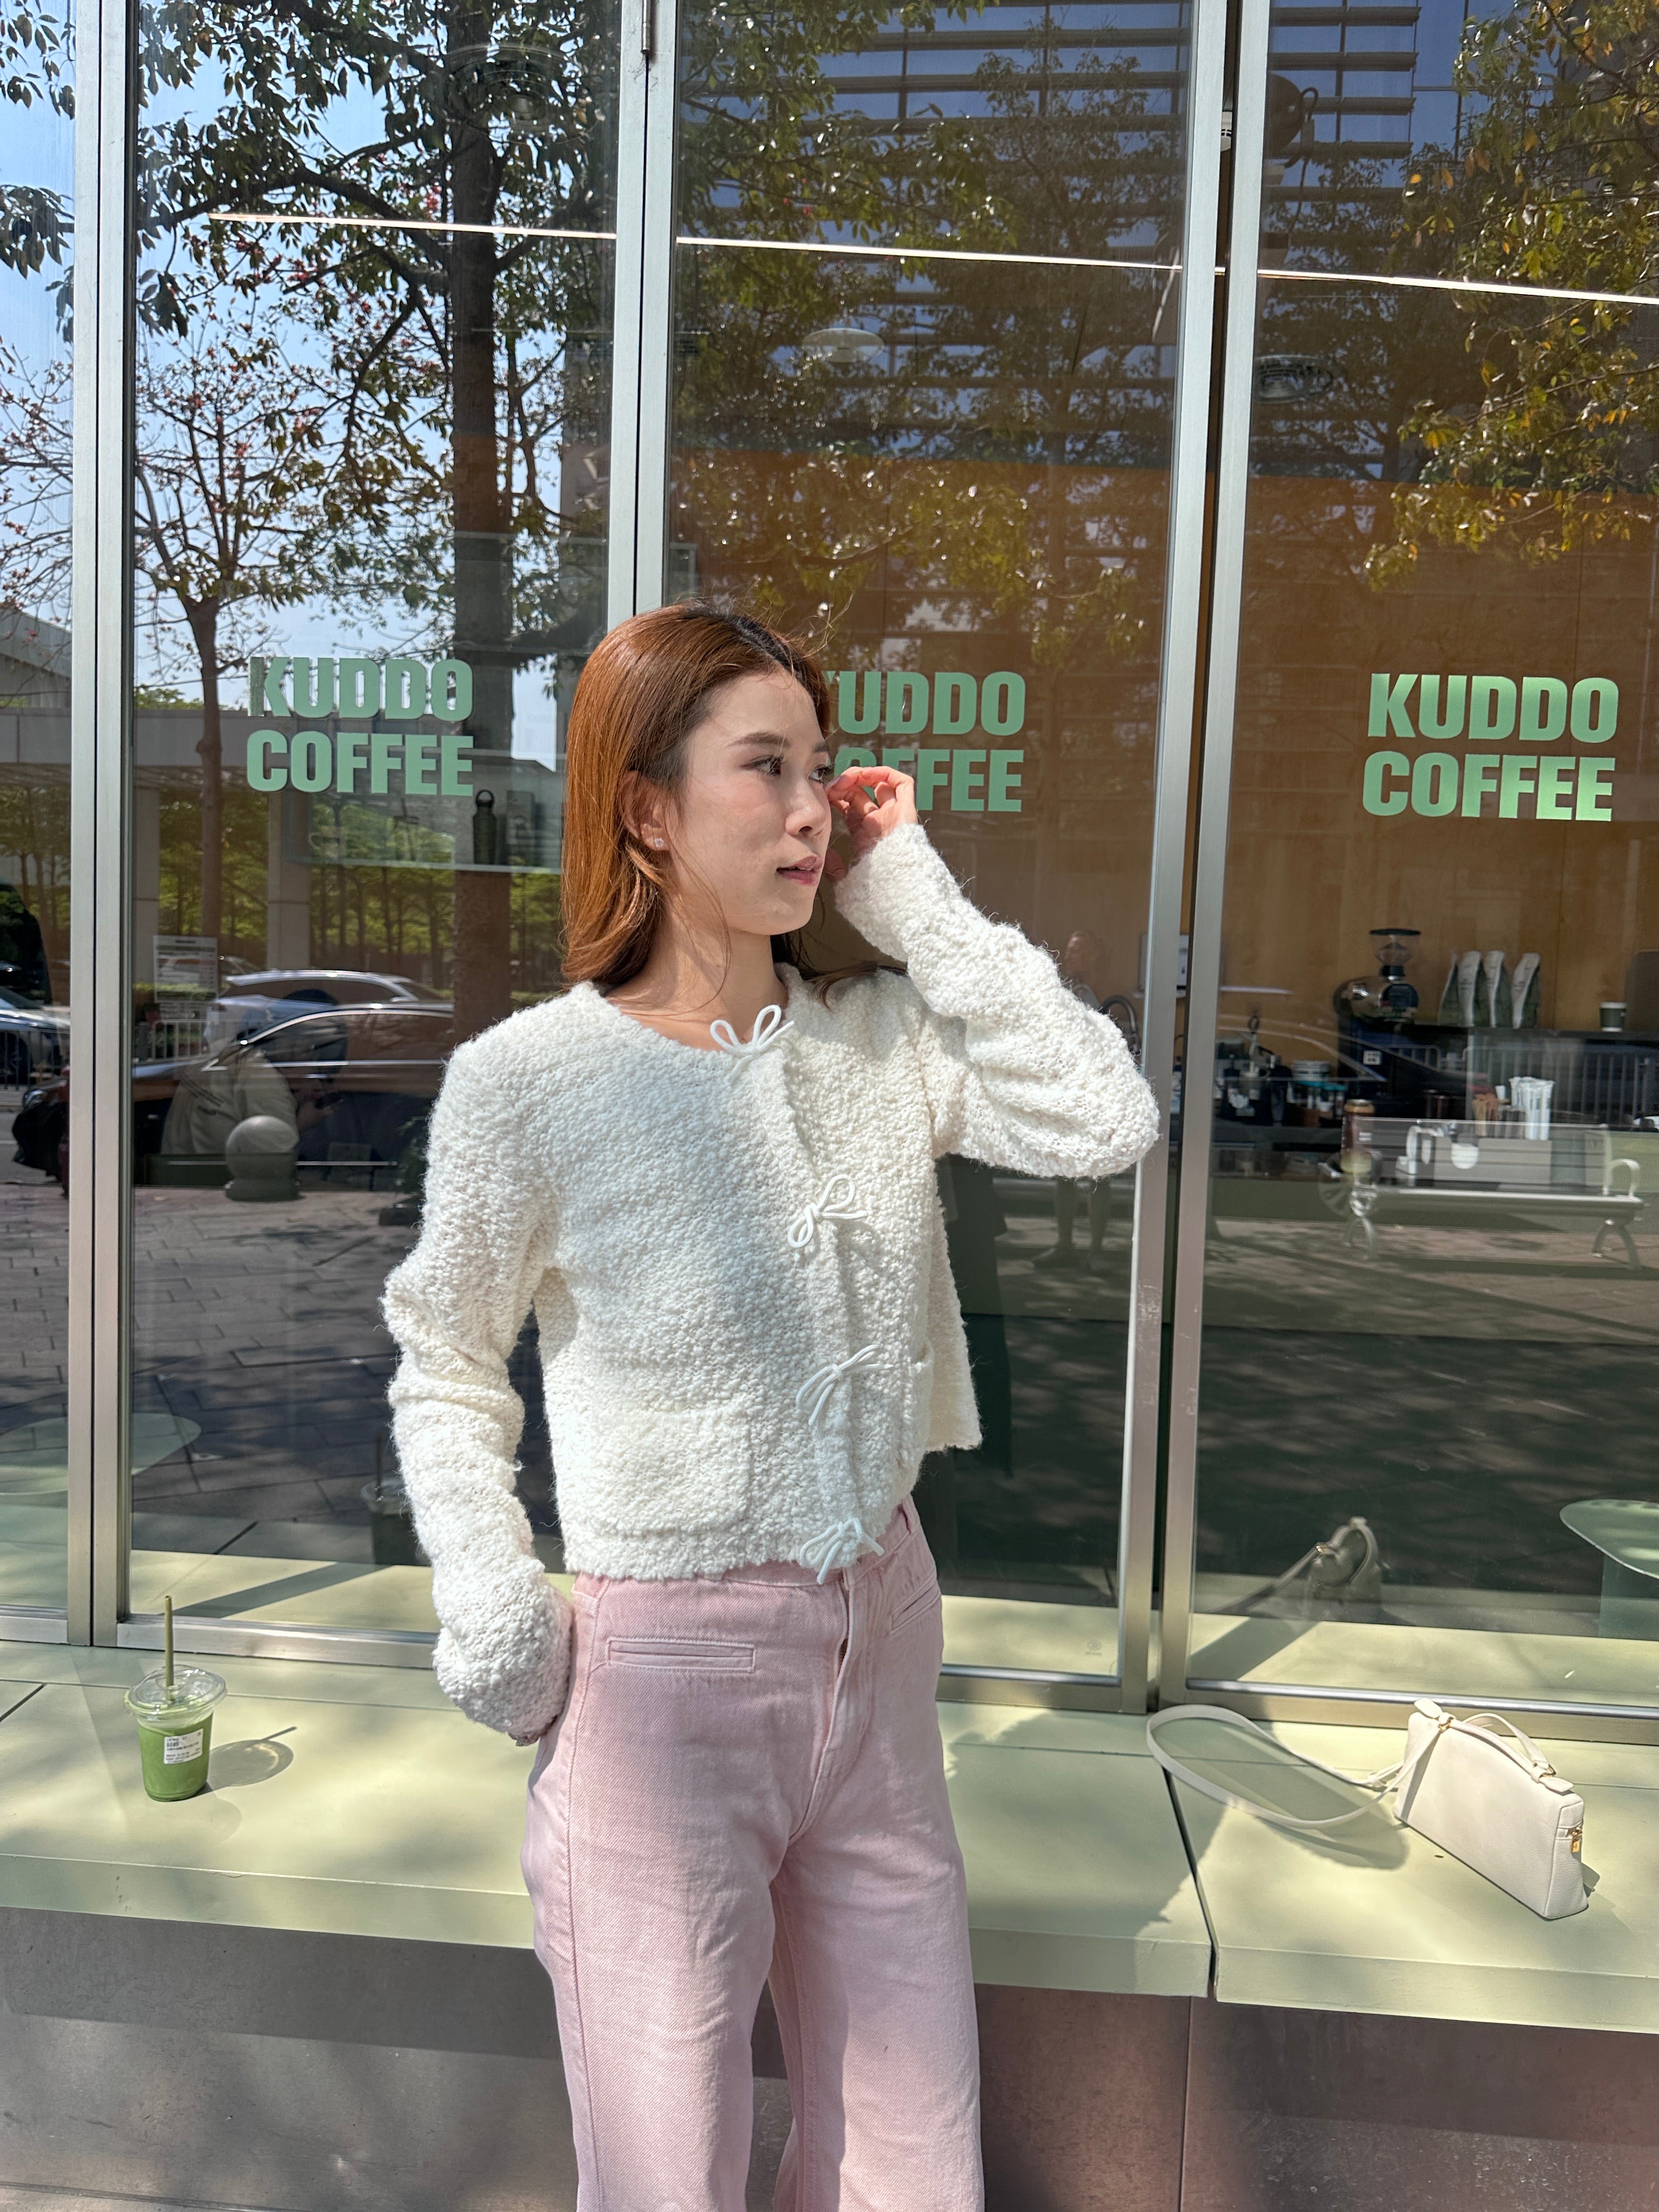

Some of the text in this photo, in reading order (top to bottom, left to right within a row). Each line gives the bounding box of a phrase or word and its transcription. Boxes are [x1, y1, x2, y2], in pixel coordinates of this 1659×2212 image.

[249, 657, 473, 722] KUDDO
[824, 671, 1025, 736] UDDO
[1368, 673, 1619, 743] KUDDO
[247, 730, 474, 796] COFFEE
[828, 747, 1024, 812] FEE
[1363, 751, 1615, 821] COFFEE
